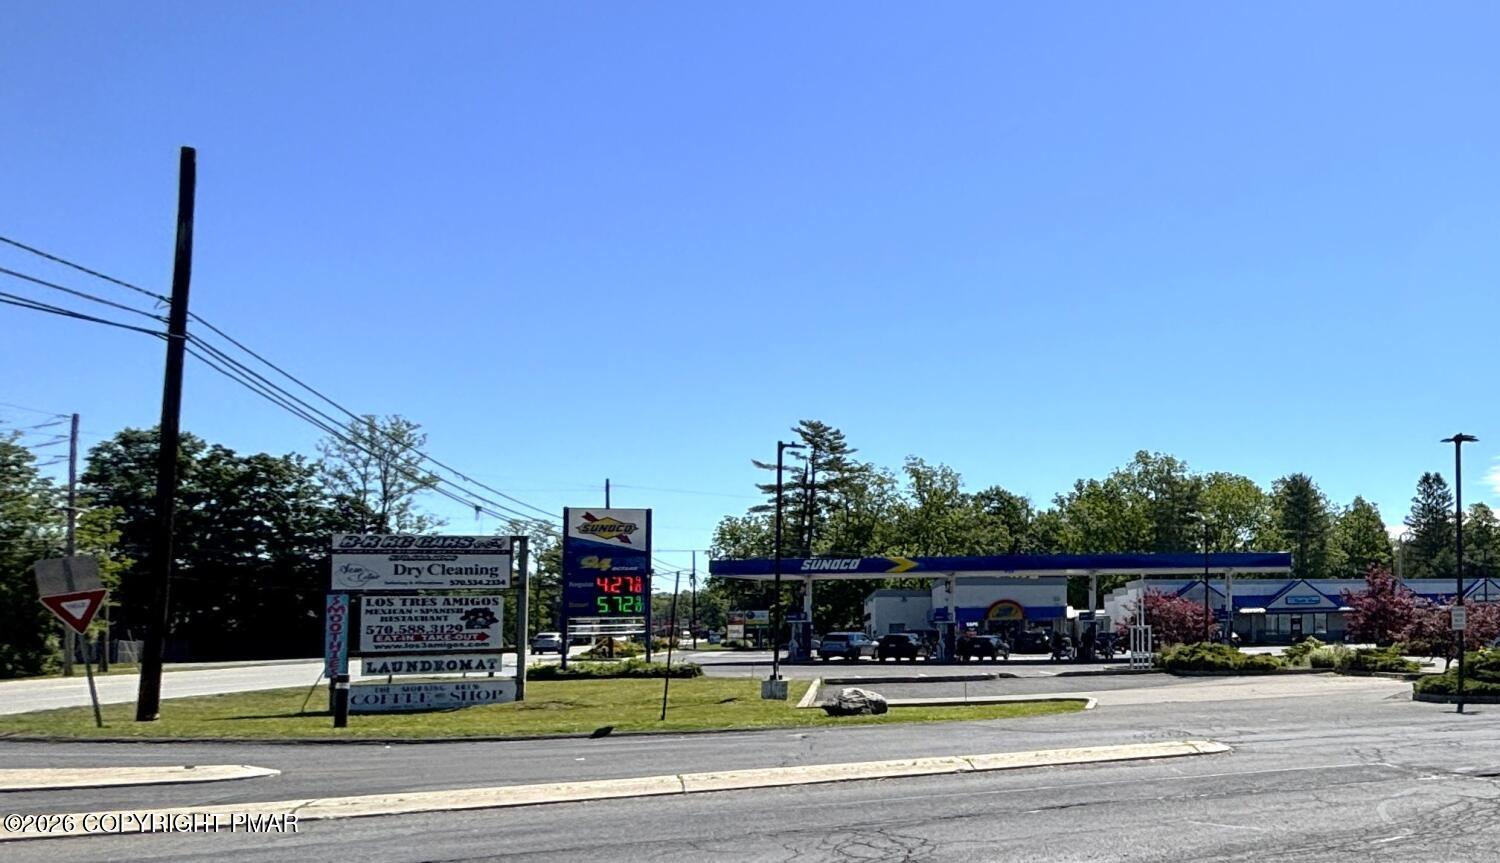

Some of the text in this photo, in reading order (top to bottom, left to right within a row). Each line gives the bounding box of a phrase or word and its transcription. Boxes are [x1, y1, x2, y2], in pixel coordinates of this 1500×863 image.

[582, 524, 633, 532] SUNOCO
[415, 535, 475, 548] CARS
[393, 563, 424, 578] Dry
[427, 563, 499, 578] Cleaning
[801, 558, 861, 571] SUNOCO
[366, 597, 499, 607] LOS TRES AMIGOS
[366, 624, 463, 635] 570.588.3129
[366, 658, 498, 674] LAUNDROMAT
[350, 689, 504, 705] COFFEE SHOP
